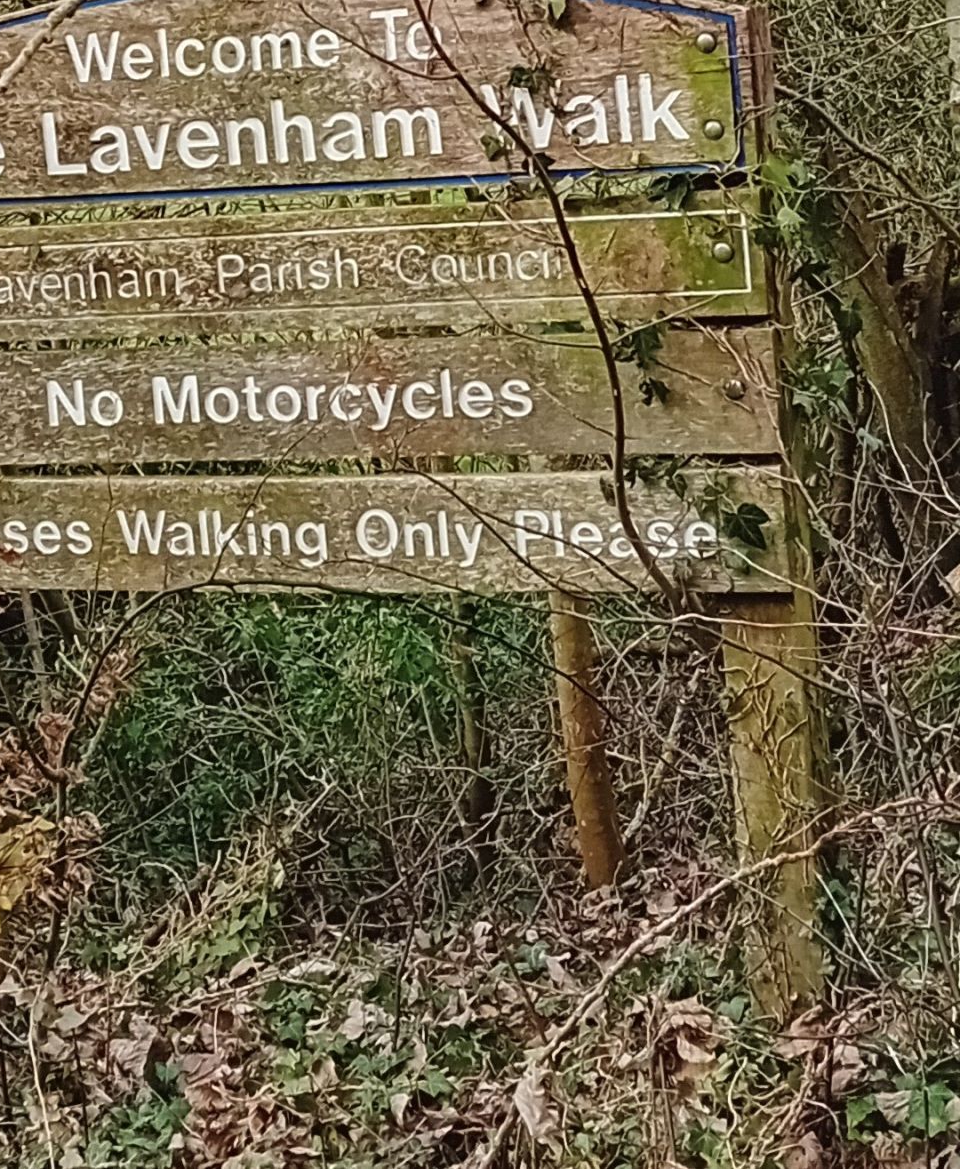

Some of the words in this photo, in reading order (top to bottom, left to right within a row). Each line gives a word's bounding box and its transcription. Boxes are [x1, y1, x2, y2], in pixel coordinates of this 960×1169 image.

[65, 27, 340, 83] Welcome
[369, 7, 442, 62] To
[41, 99, 444, 177] Lavenham
[480, 73, 690, 150] Walk
[217, 248, 360, 294] Parish
[46, 378, 125, 427] No
[152, 368, 534, 431] Motorcycles
[115, 508, 329, 569] Walking
[356, 508, 484, 568] Only
[514, 508, 719, 560] Please
